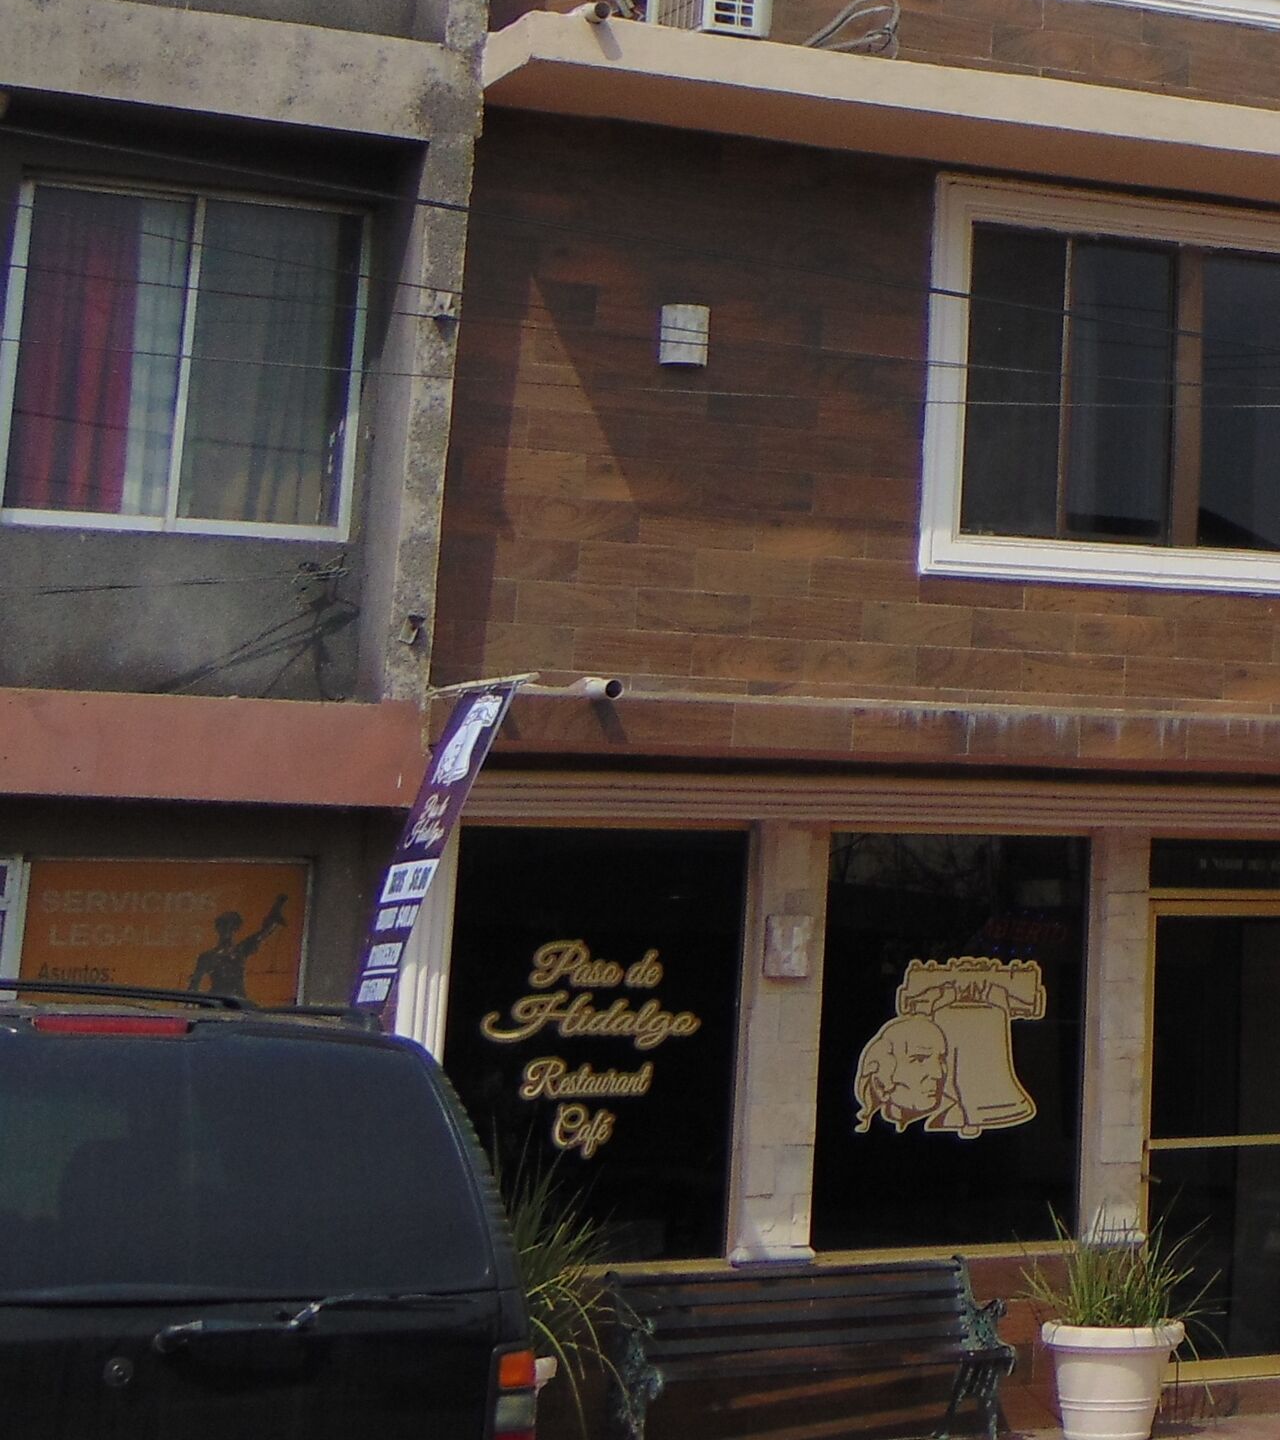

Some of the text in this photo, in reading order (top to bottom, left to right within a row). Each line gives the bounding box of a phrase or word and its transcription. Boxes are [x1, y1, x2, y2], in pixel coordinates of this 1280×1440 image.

[43, 888, 216, 912] SERVICIOS
[50, 922, 206, 947] LEGALES
[37, 962, 116, 983] Asuntos:
[528, 939, 664, 988] Paso de
[479, 990, 701, 1050] Hidalgo
[518, 1056, 655, 1101] Restaurant
[552, 1103, 616, 1159] Café
